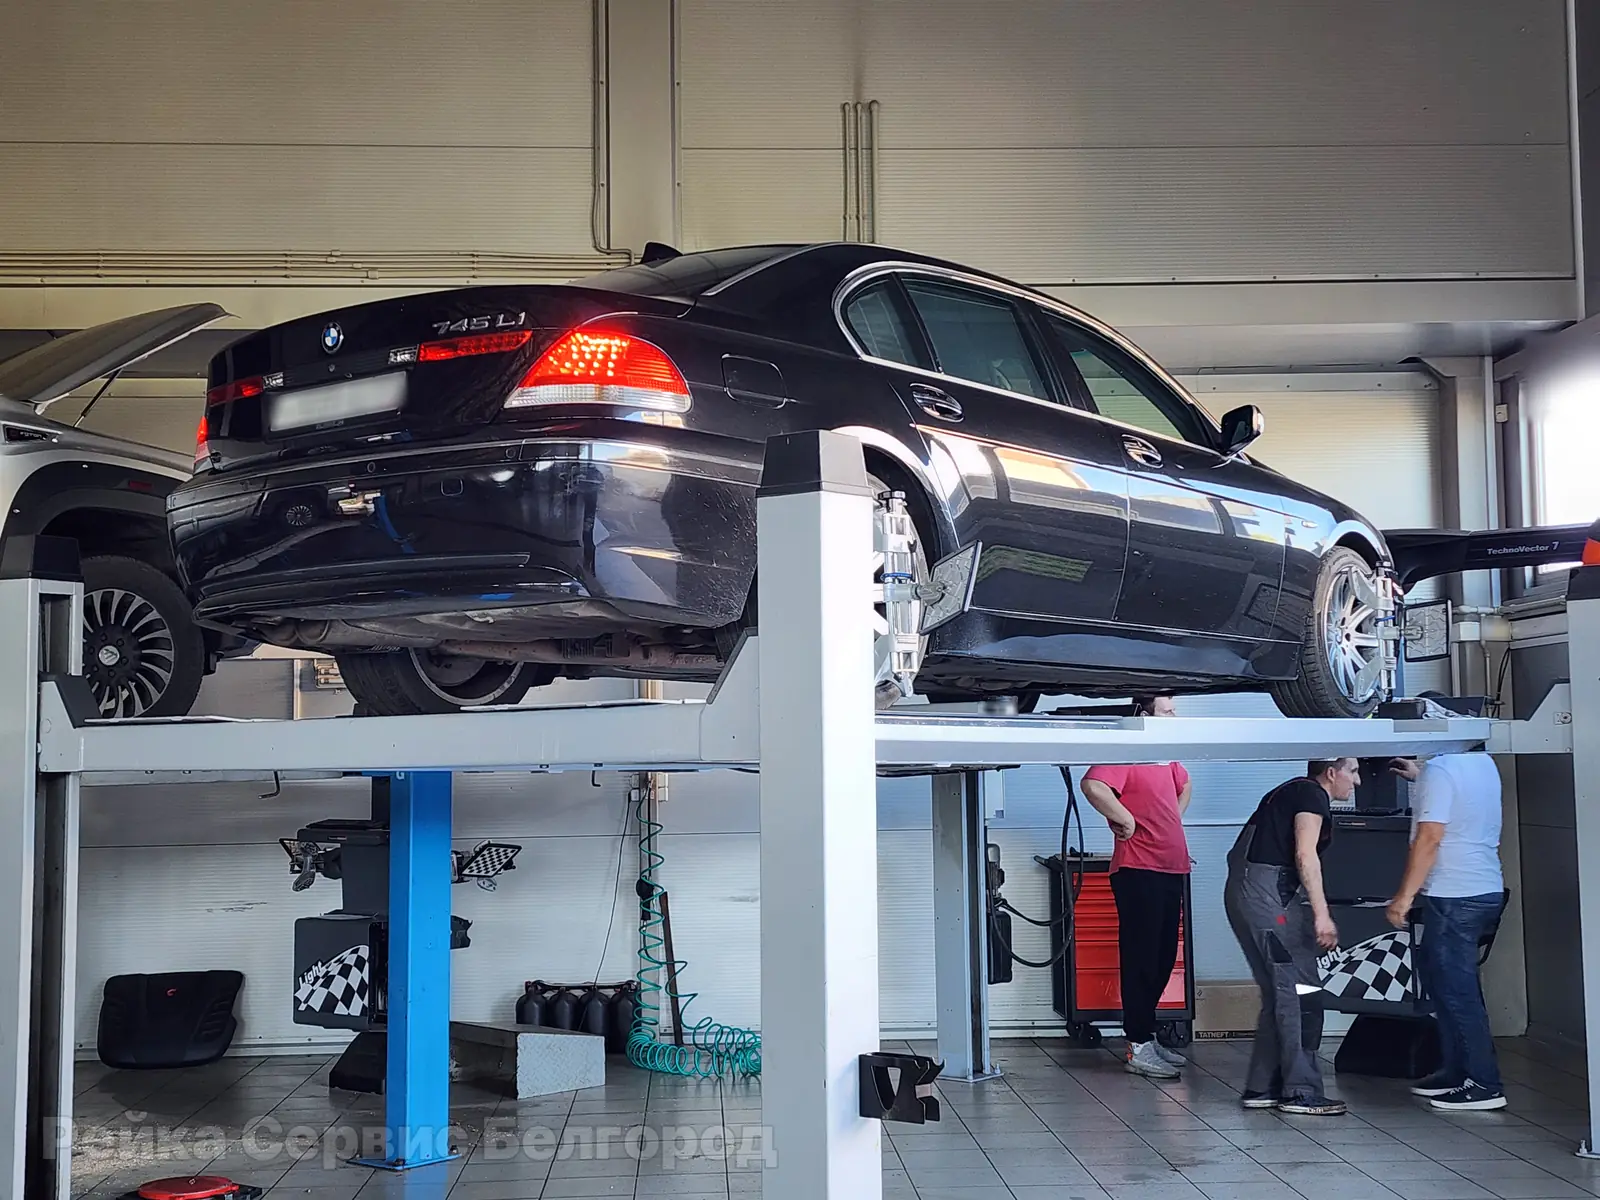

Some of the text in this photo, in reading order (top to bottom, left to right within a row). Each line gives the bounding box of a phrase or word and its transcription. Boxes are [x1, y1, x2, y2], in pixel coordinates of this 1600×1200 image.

[1487, 541, 1559, 555] TechnoVector 7
[1316, 946, 1342, 969] ight
[299, 960, 322, 989] Light
